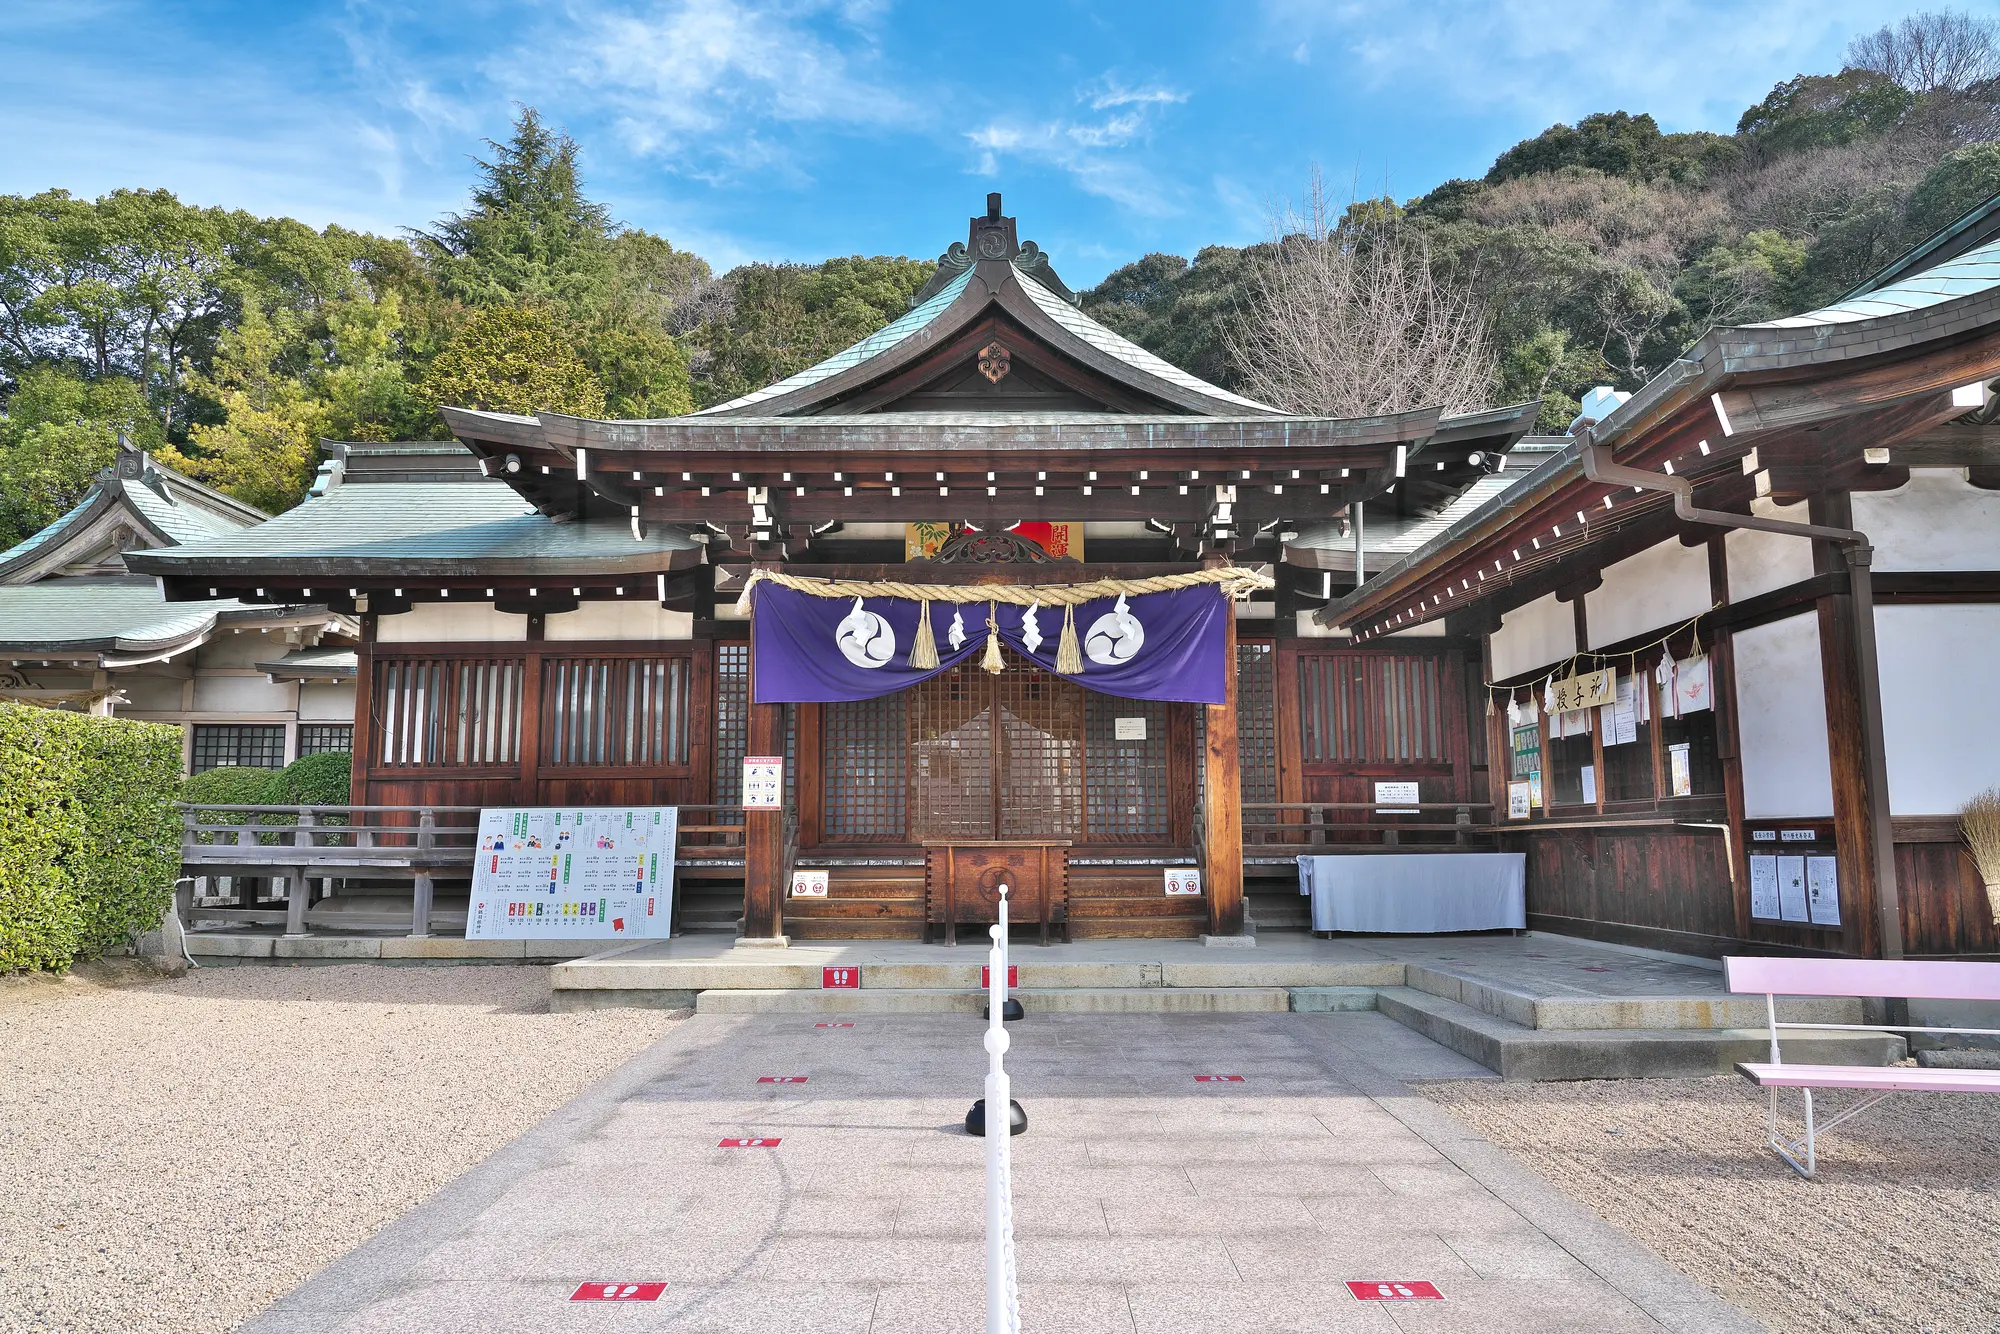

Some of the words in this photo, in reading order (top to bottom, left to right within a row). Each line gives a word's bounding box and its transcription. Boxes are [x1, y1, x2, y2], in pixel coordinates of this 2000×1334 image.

[1050, 524, 1069, 558] 開運
[1556, 675, 1603, 711] 授与所
